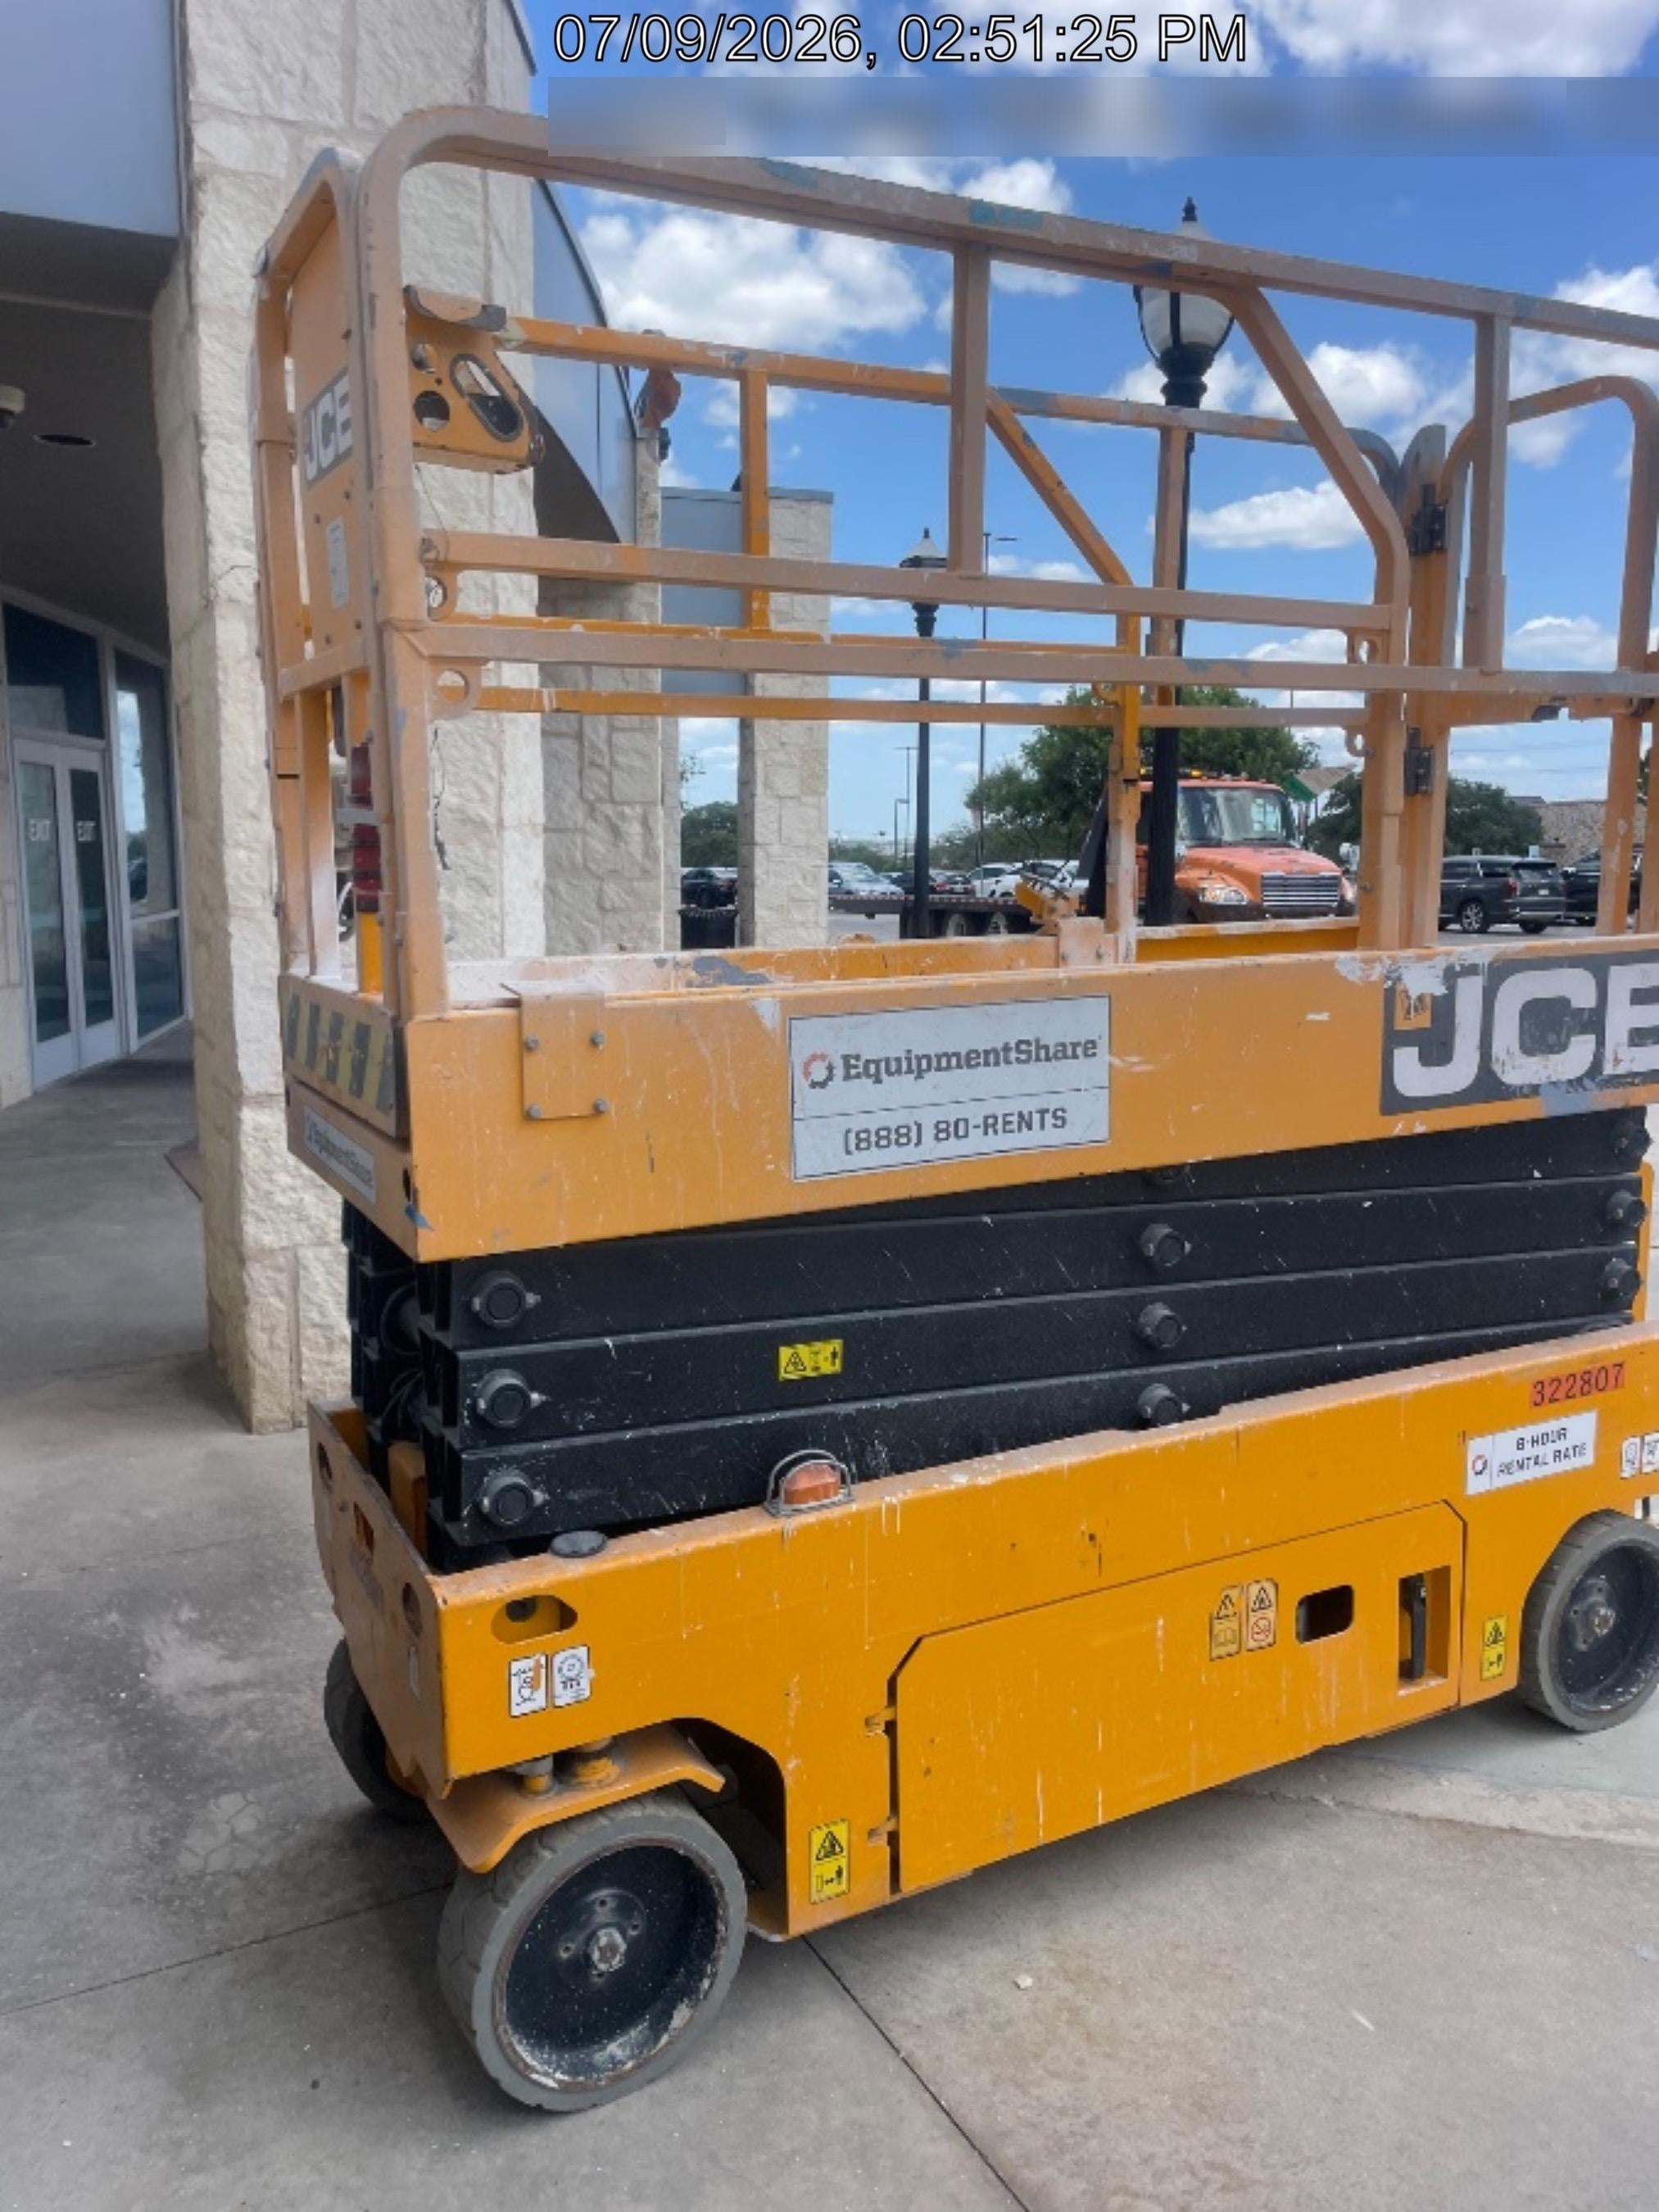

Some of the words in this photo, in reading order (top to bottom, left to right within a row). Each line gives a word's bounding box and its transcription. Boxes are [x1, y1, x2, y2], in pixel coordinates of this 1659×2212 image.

[841, 1037, 1099, 1084] EquipmentShare
[844, 1122, 922, 1155] (888)
[933, 1108, 1067, 1141] 80-RENTS
[1533, 1362, 1625, 1407] 322807
[1497, 1453, 1549, 1477] RENTAL
[1553, 1442, 1587, 1463] RATE
